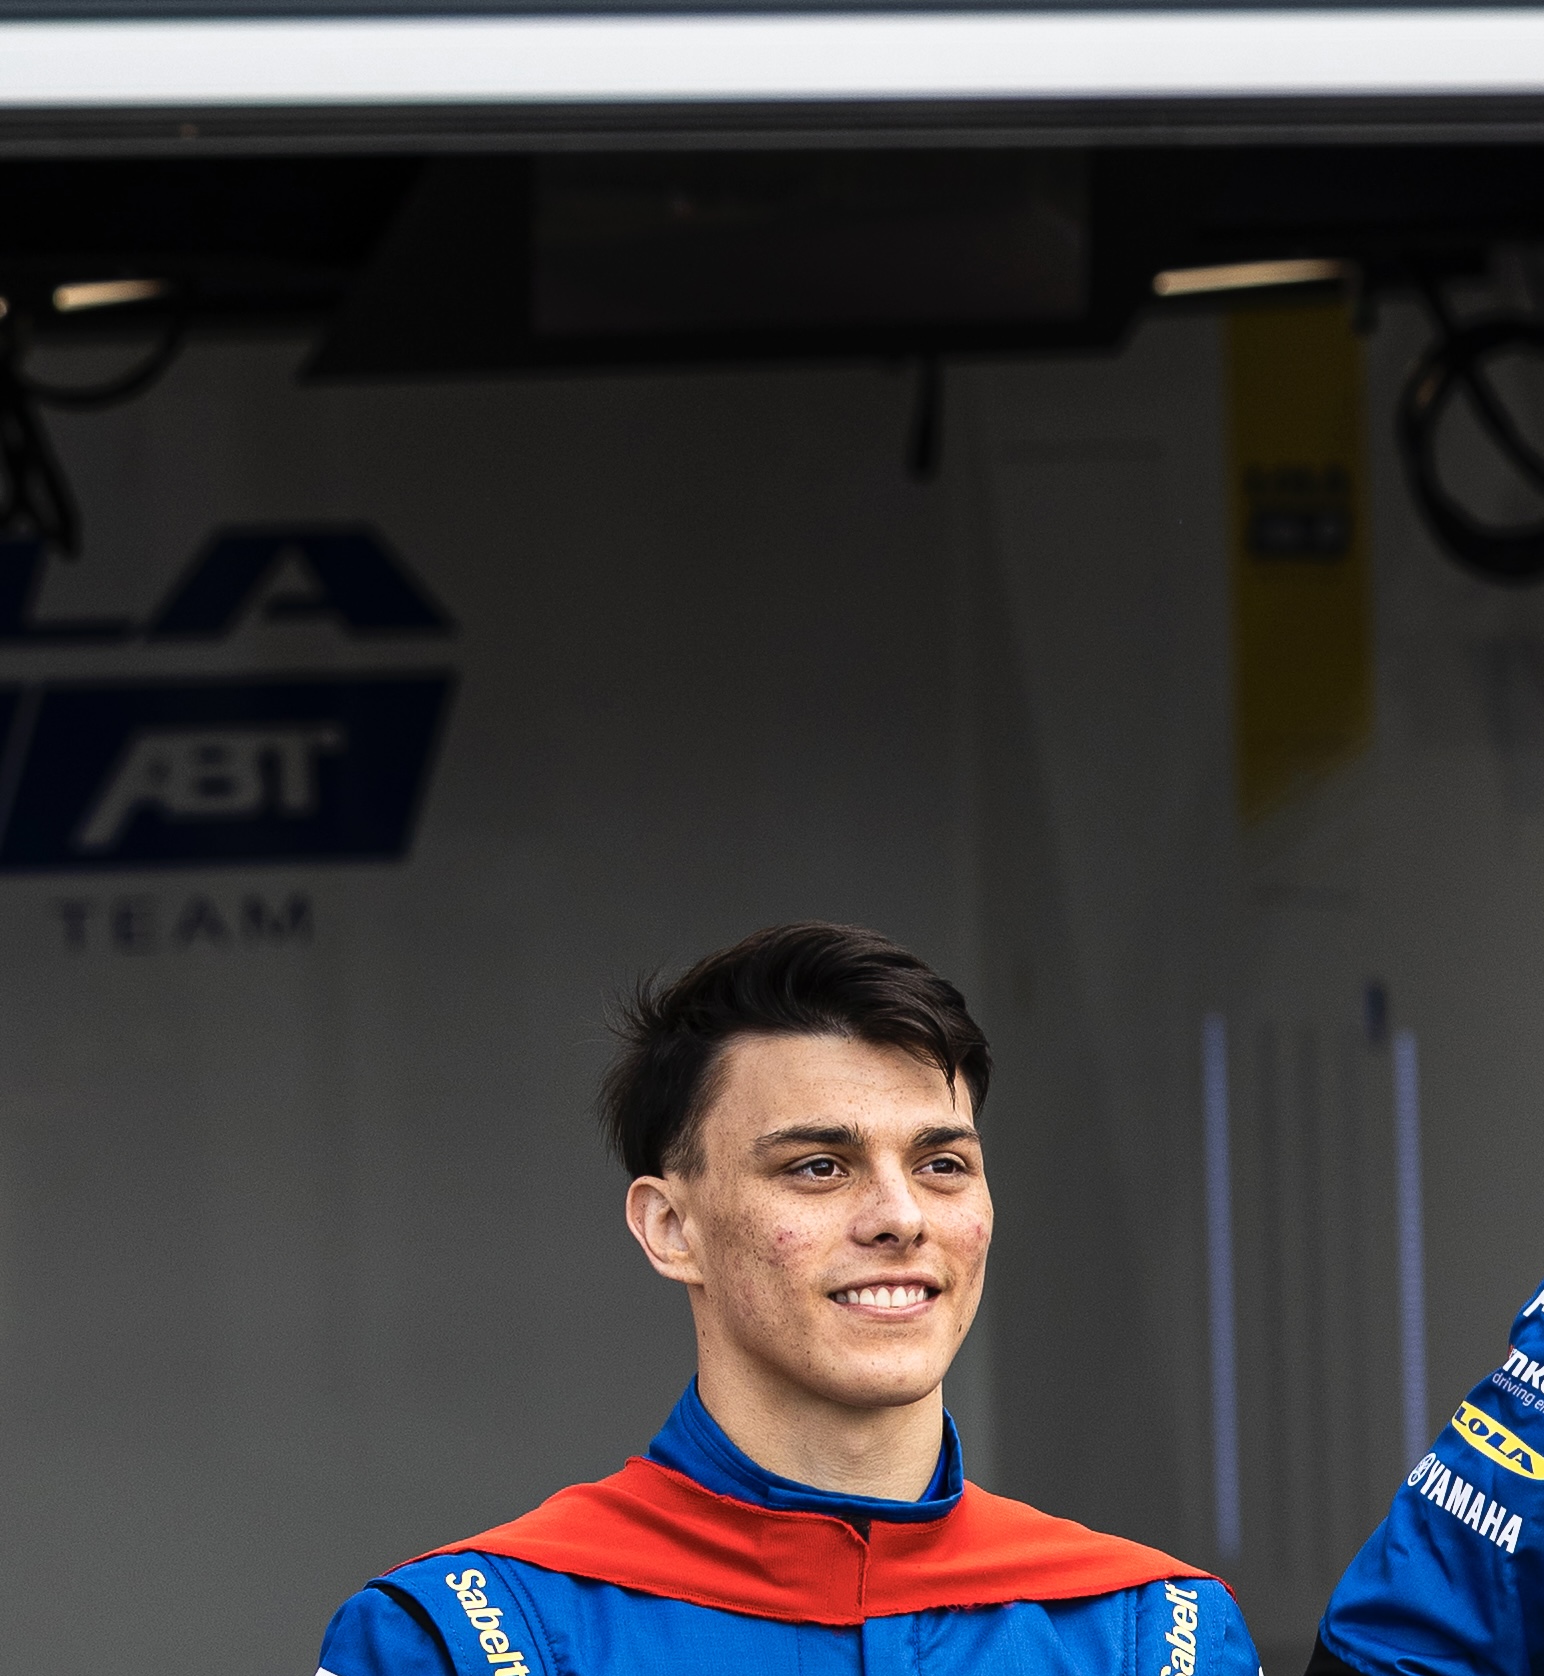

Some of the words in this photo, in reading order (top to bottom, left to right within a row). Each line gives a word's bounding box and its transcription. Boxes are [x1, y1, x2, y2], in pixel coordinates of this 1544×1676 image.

[75, 727, 345, 855] ABT
[58, 896, 312, 955] TEAM
[1492, 1372, 1536, 1407] driving
[1455, 1405, 1535, 1475] LOLA
[1420, 1459, 1523, 1554] YAMAHA
